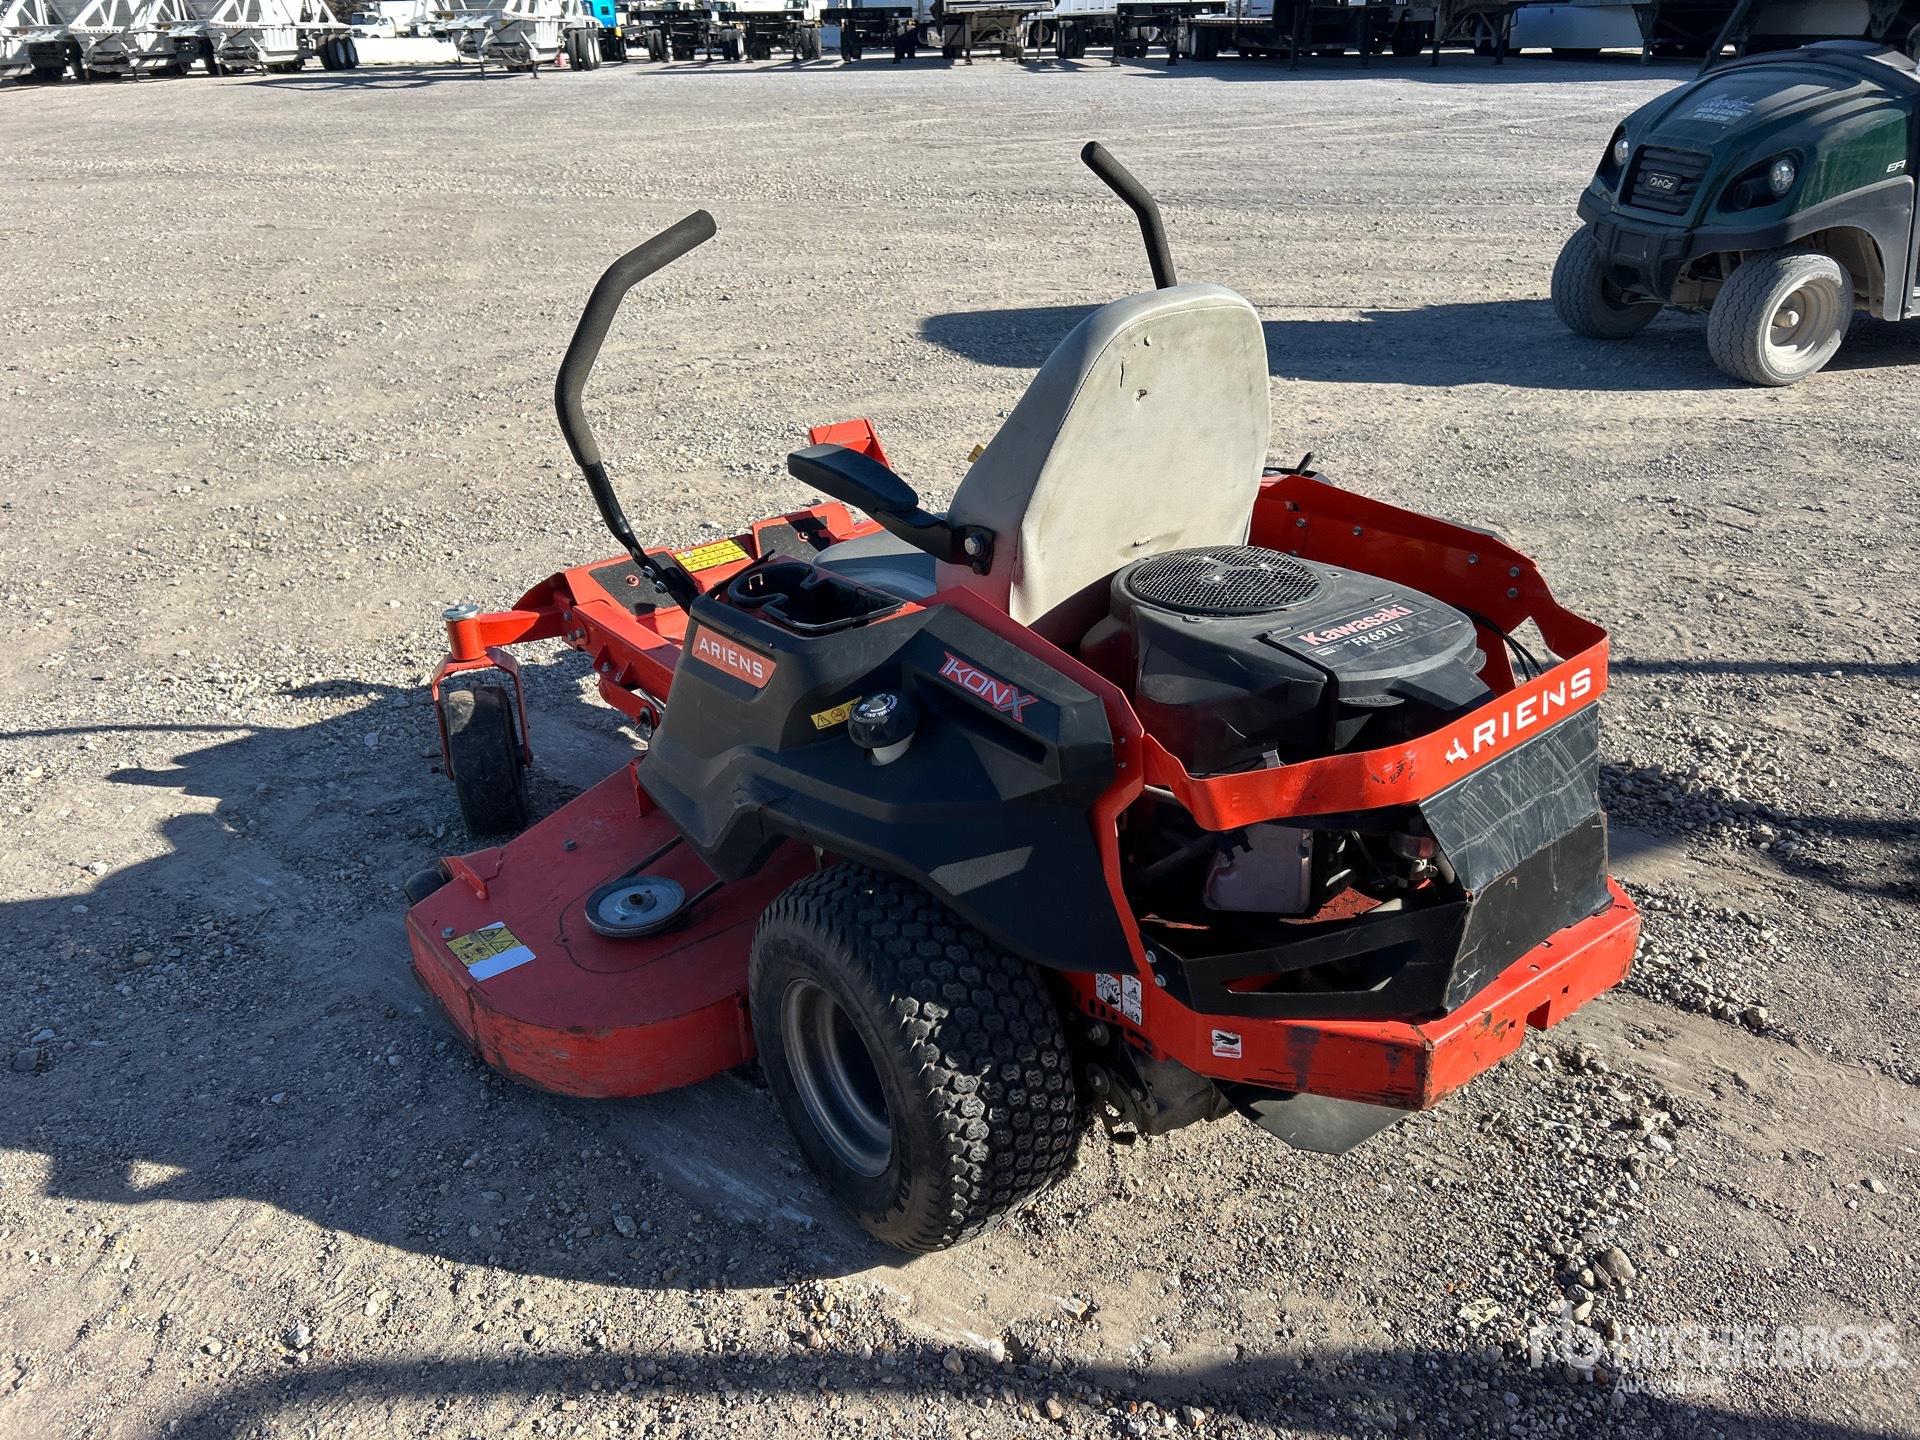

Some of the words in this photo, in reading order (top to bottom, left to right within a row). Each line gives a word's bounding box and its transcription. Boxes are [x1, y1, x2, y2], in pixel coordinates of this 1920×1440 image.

[1298, 604, 1414, 646] Kawasaki
[1350, 624, 1404, 647] FR691V
[699, 637, 763, 679] ARIENS
[1445, 667, 1591, 764] ARIENS
